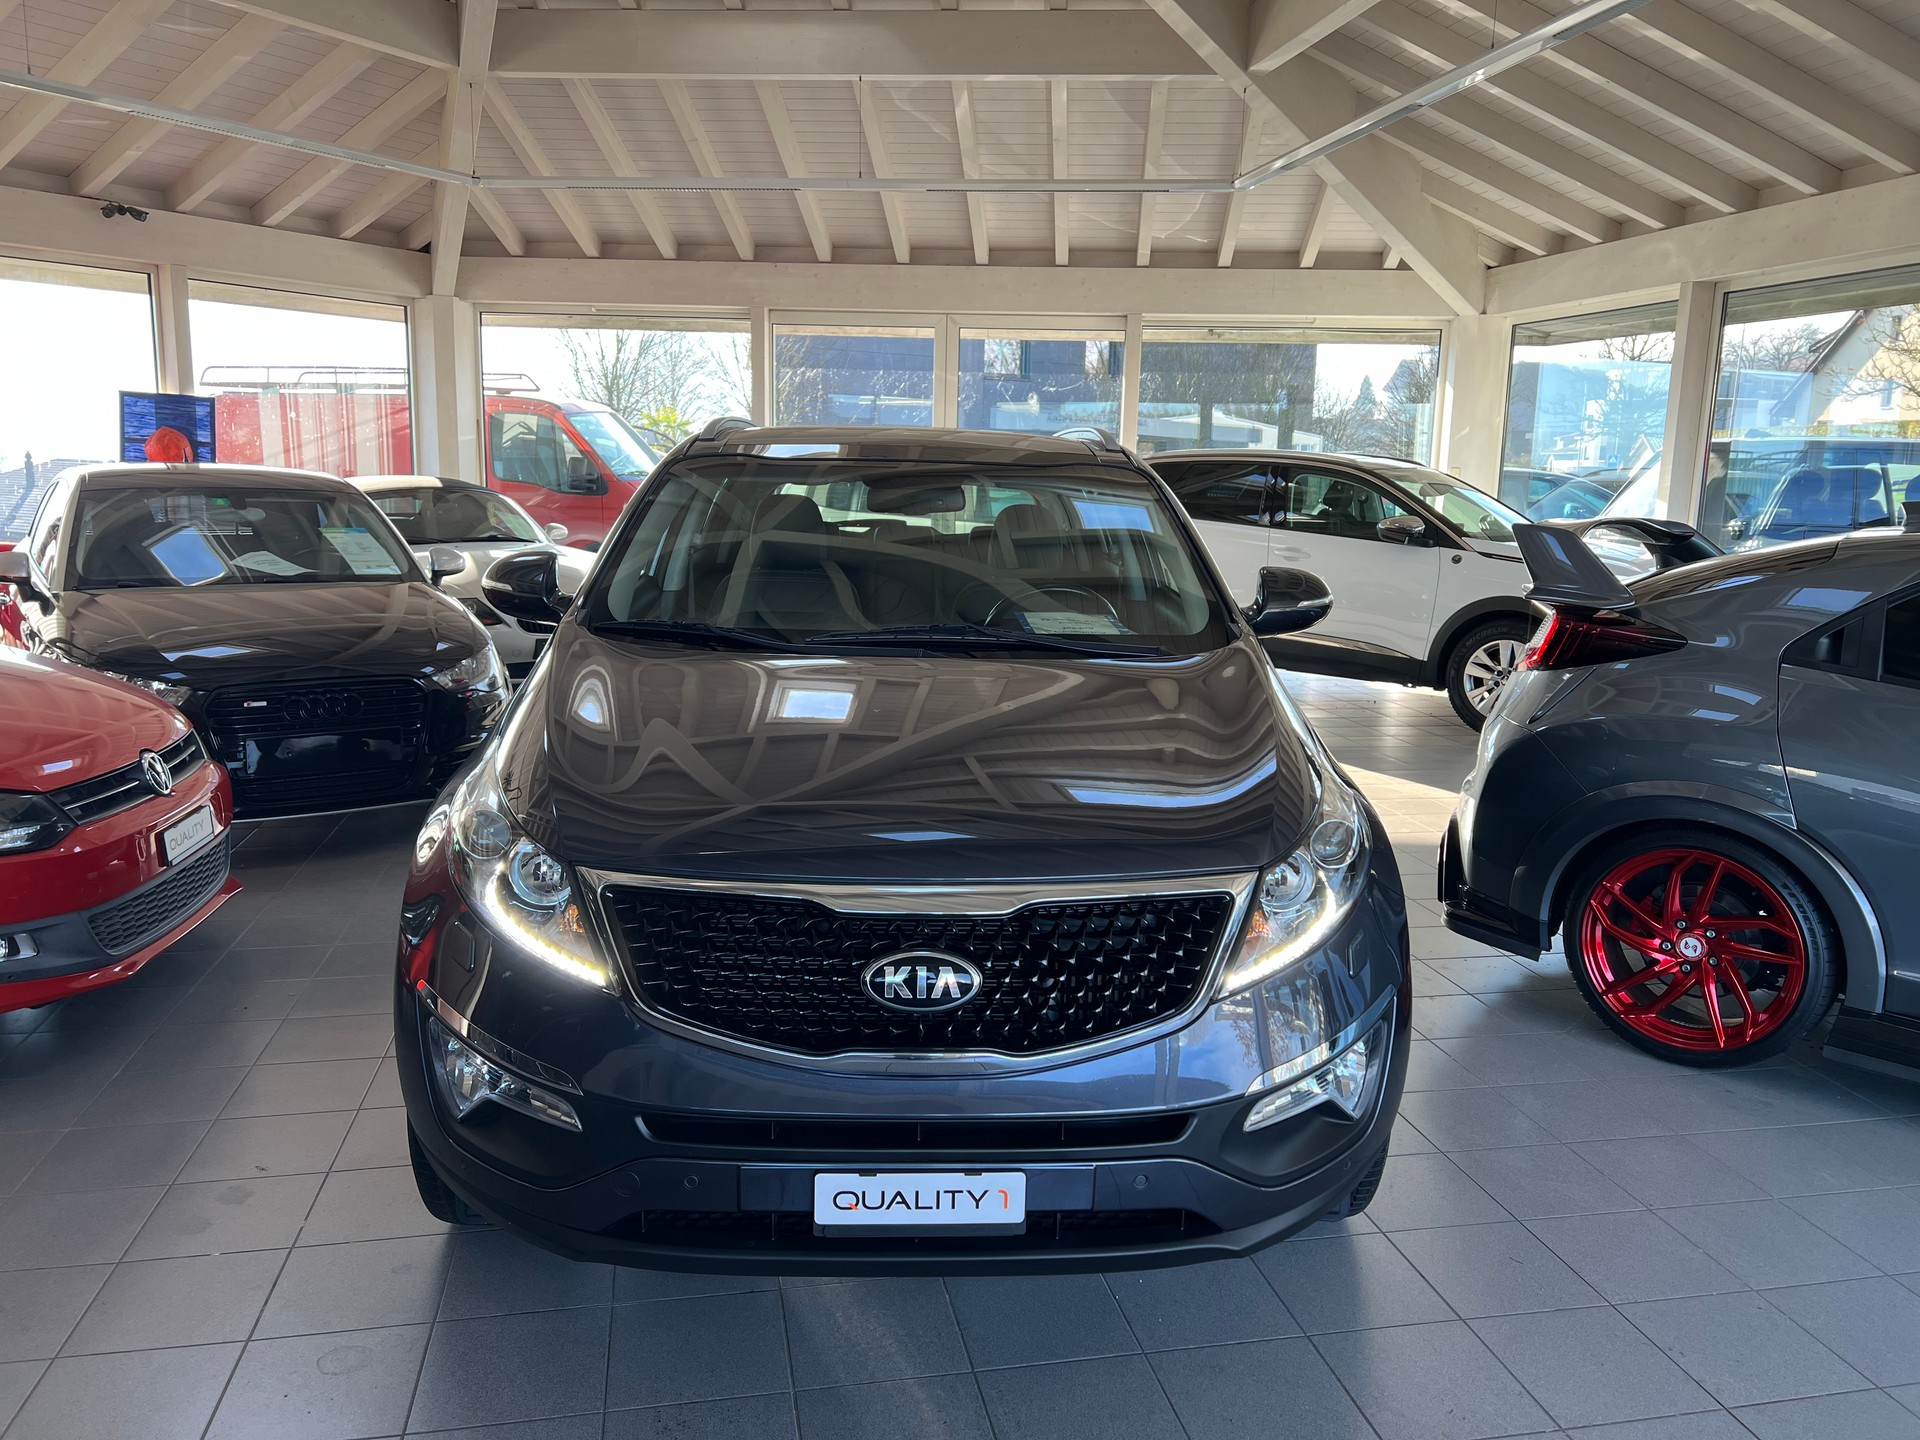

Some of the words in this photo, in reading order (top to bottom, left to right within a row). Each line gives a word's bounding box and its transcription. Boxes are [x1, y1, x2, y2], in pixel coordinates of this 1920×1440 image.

[1465, 626, 1509, 648] MICHELIN
[169, 819, 204, 851] QUALITY
[883, 966, 961, 999] KIA
[832, 1189, 990, 1211] QUALITY
[997, 1189, 1009, 1210] 1
